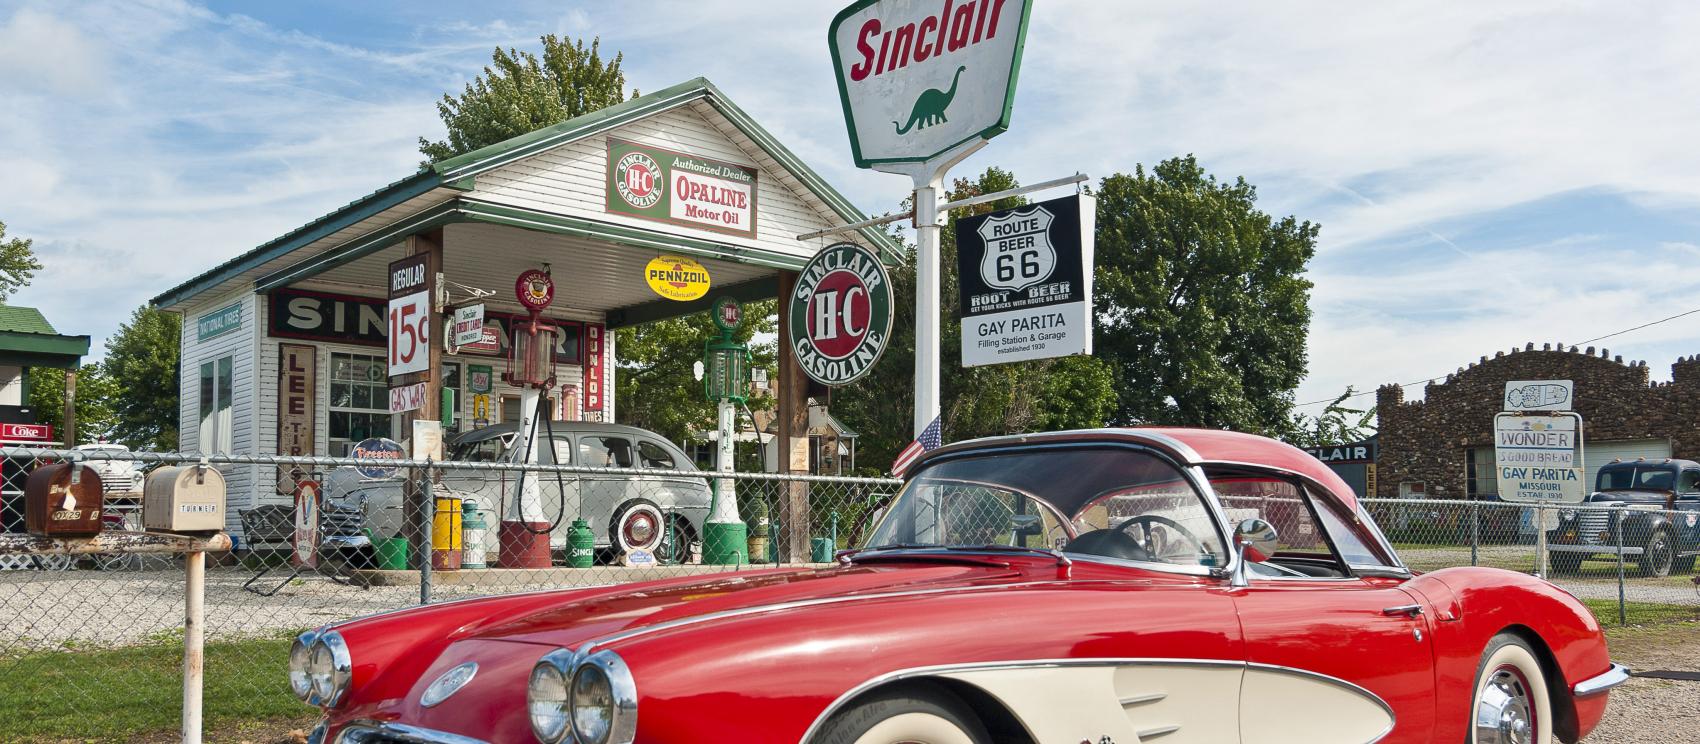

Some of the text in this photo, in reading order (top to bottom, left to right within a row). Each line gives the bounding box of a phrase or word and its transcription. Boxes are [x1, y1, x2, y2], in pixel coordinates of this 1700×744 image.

[850, 0, 1004, 82] Sinclair
[619, 153, 661, 181] SINCLAIR
[672, 156, 752, 183] Authorized Dealer
[618, 180, 661, 207] GASOLINE
[676, 175, 748, 210] OPALINE
[684, 203, 740, 225] Motor Oil
[993, 217, 1039, 237] ROUTE
[999, 236, 1035, 252] BEER
[650, 269, 708, 284] PENNZOIL
[797, 250, 882, 303] SINCLAIR
[996, 250, 1040, 282] 66
[393, 263, 425, 292] REGULAR
[970, 280, 1071, 307] ROOT BEER
[996, 302, 1011, 310] KICKS
[1012, 299, 1027, 307] WITH
[1027, 297, 1045, 305] ROUTE
[456, 320, 470, 334] CREDIT
[978, 312, 1066, 337] GAY PARITA
[978, 331, 1067, 349] Filling Station & Garage
[997, 342, 1046, 355] established 1930
[796, 330, 884, 381] GASOLINE
[588, 326, 599, 408] DUNLOP
[288, 353, 305, 415] LEE
[391, 383, 427, 412] GAS WAR
[584, 411, 603, 423] TIRES
[12, 425, 39, 438] Coke
[1500, 432, 1568, 446] WONDER
[1507, 451, 1535, 463] GOOD
[1537, 452, 1572, 463] BREAD
[1502, 467, 1528, 480] GAY
[1519, 482, 1561, 491] MISSOURI
[181, 505, 216, 513] TURNER
